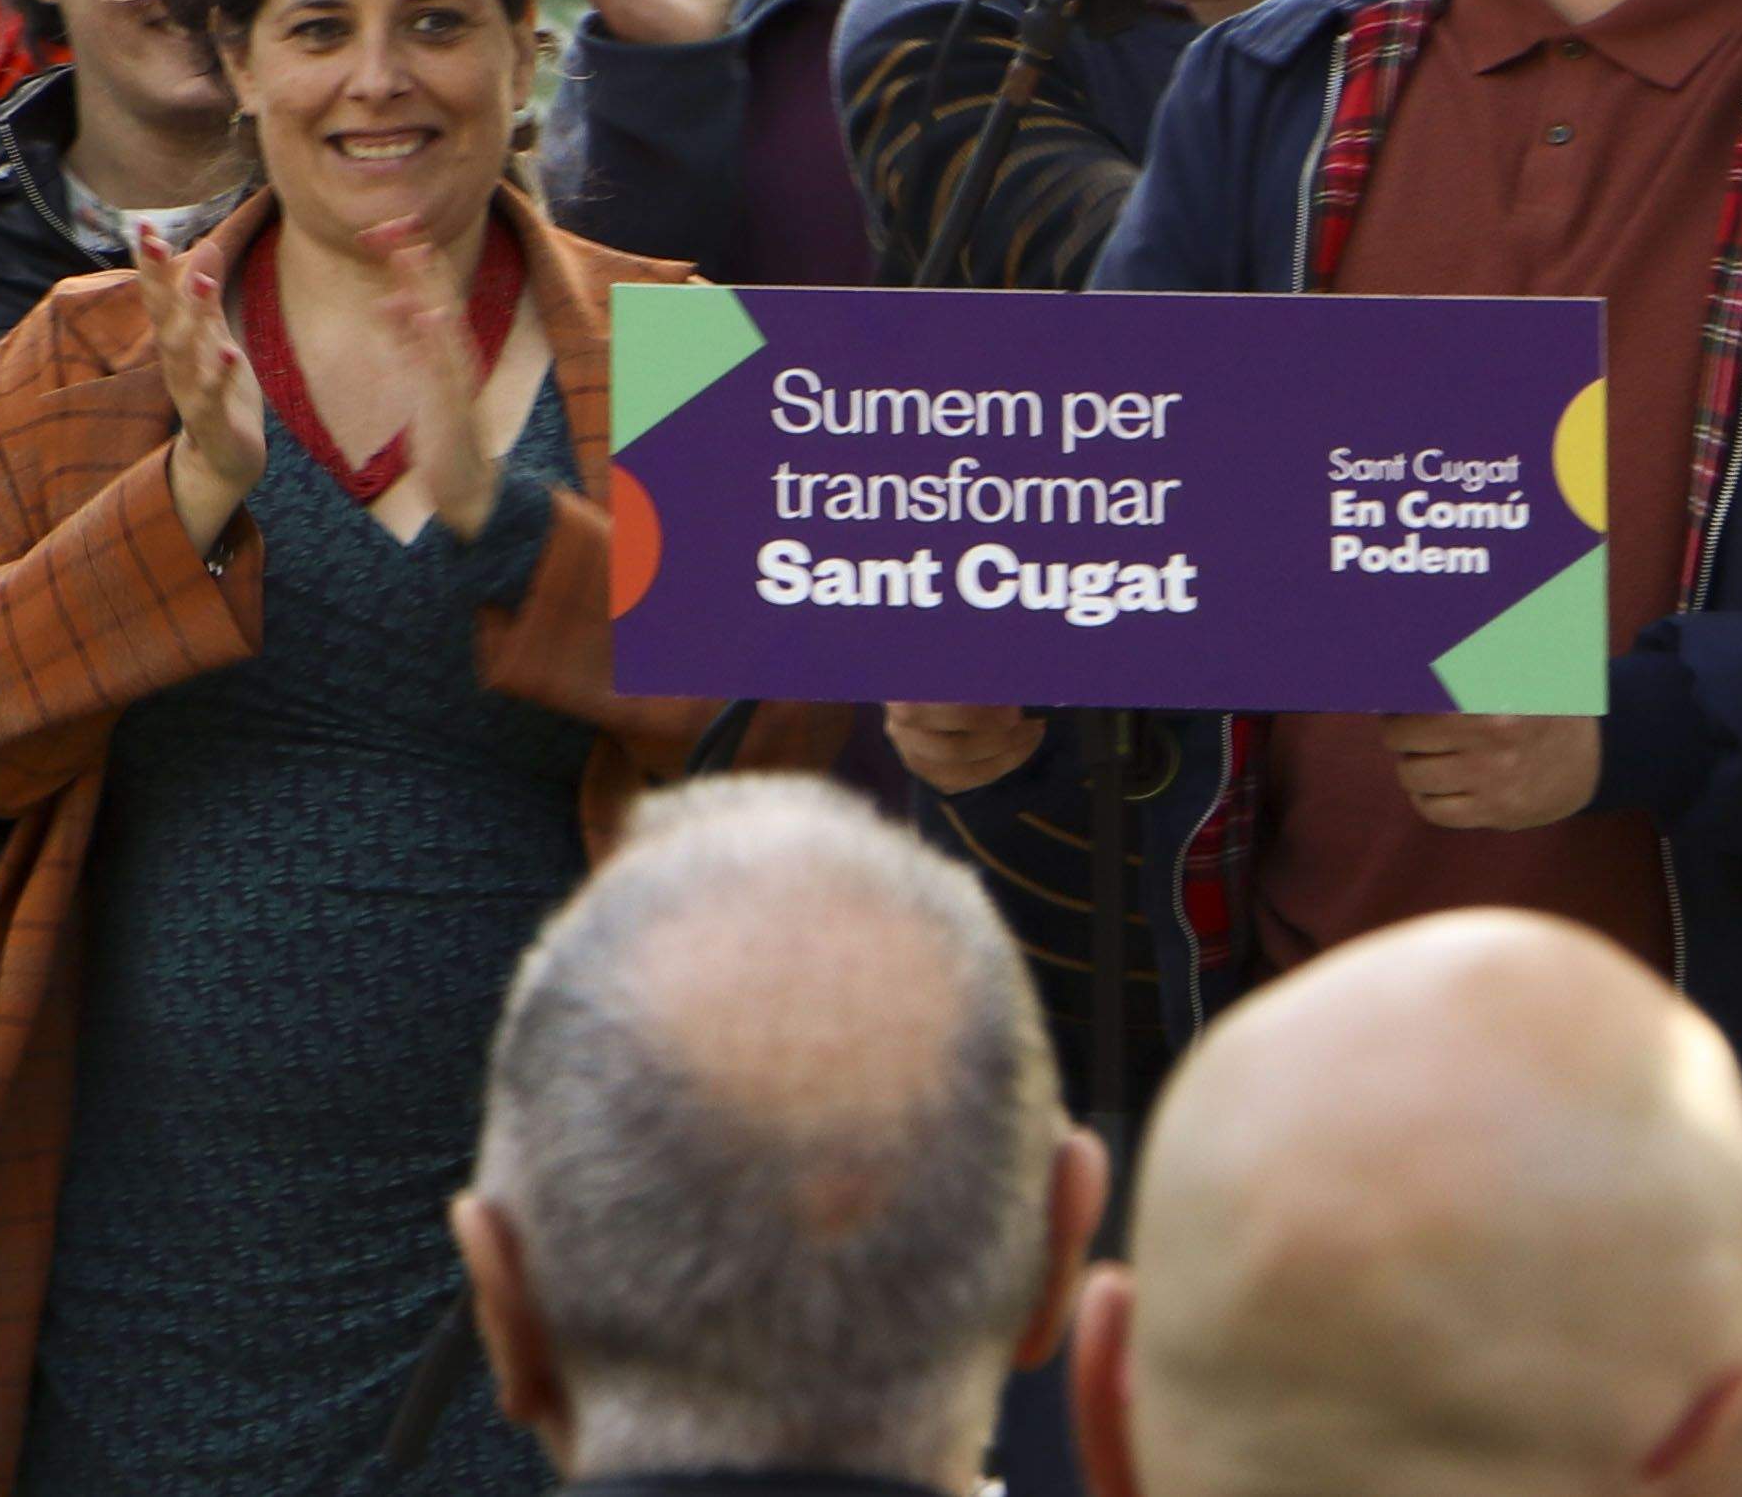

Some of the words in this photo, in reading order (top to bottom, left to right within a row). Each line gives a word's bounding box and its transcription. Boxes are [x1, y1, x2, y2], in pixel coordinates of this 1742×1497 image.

[772, 368, 1042, 436] Sumem
[1063, 392, 1182, 453] per
[771, 457, 1181, 525] transformar
[1329, 448, 1406, 481] Sant
[1411, 448, 1521, 492] Cugat
[1331, 490, 1385, 527] En
[1396, 490, 1530, 530] Comú
[1331, 533, 1489, 573] Podem
[756, 539, 942, 607] Sant
[956, 544, 1197, 626] Cugat
